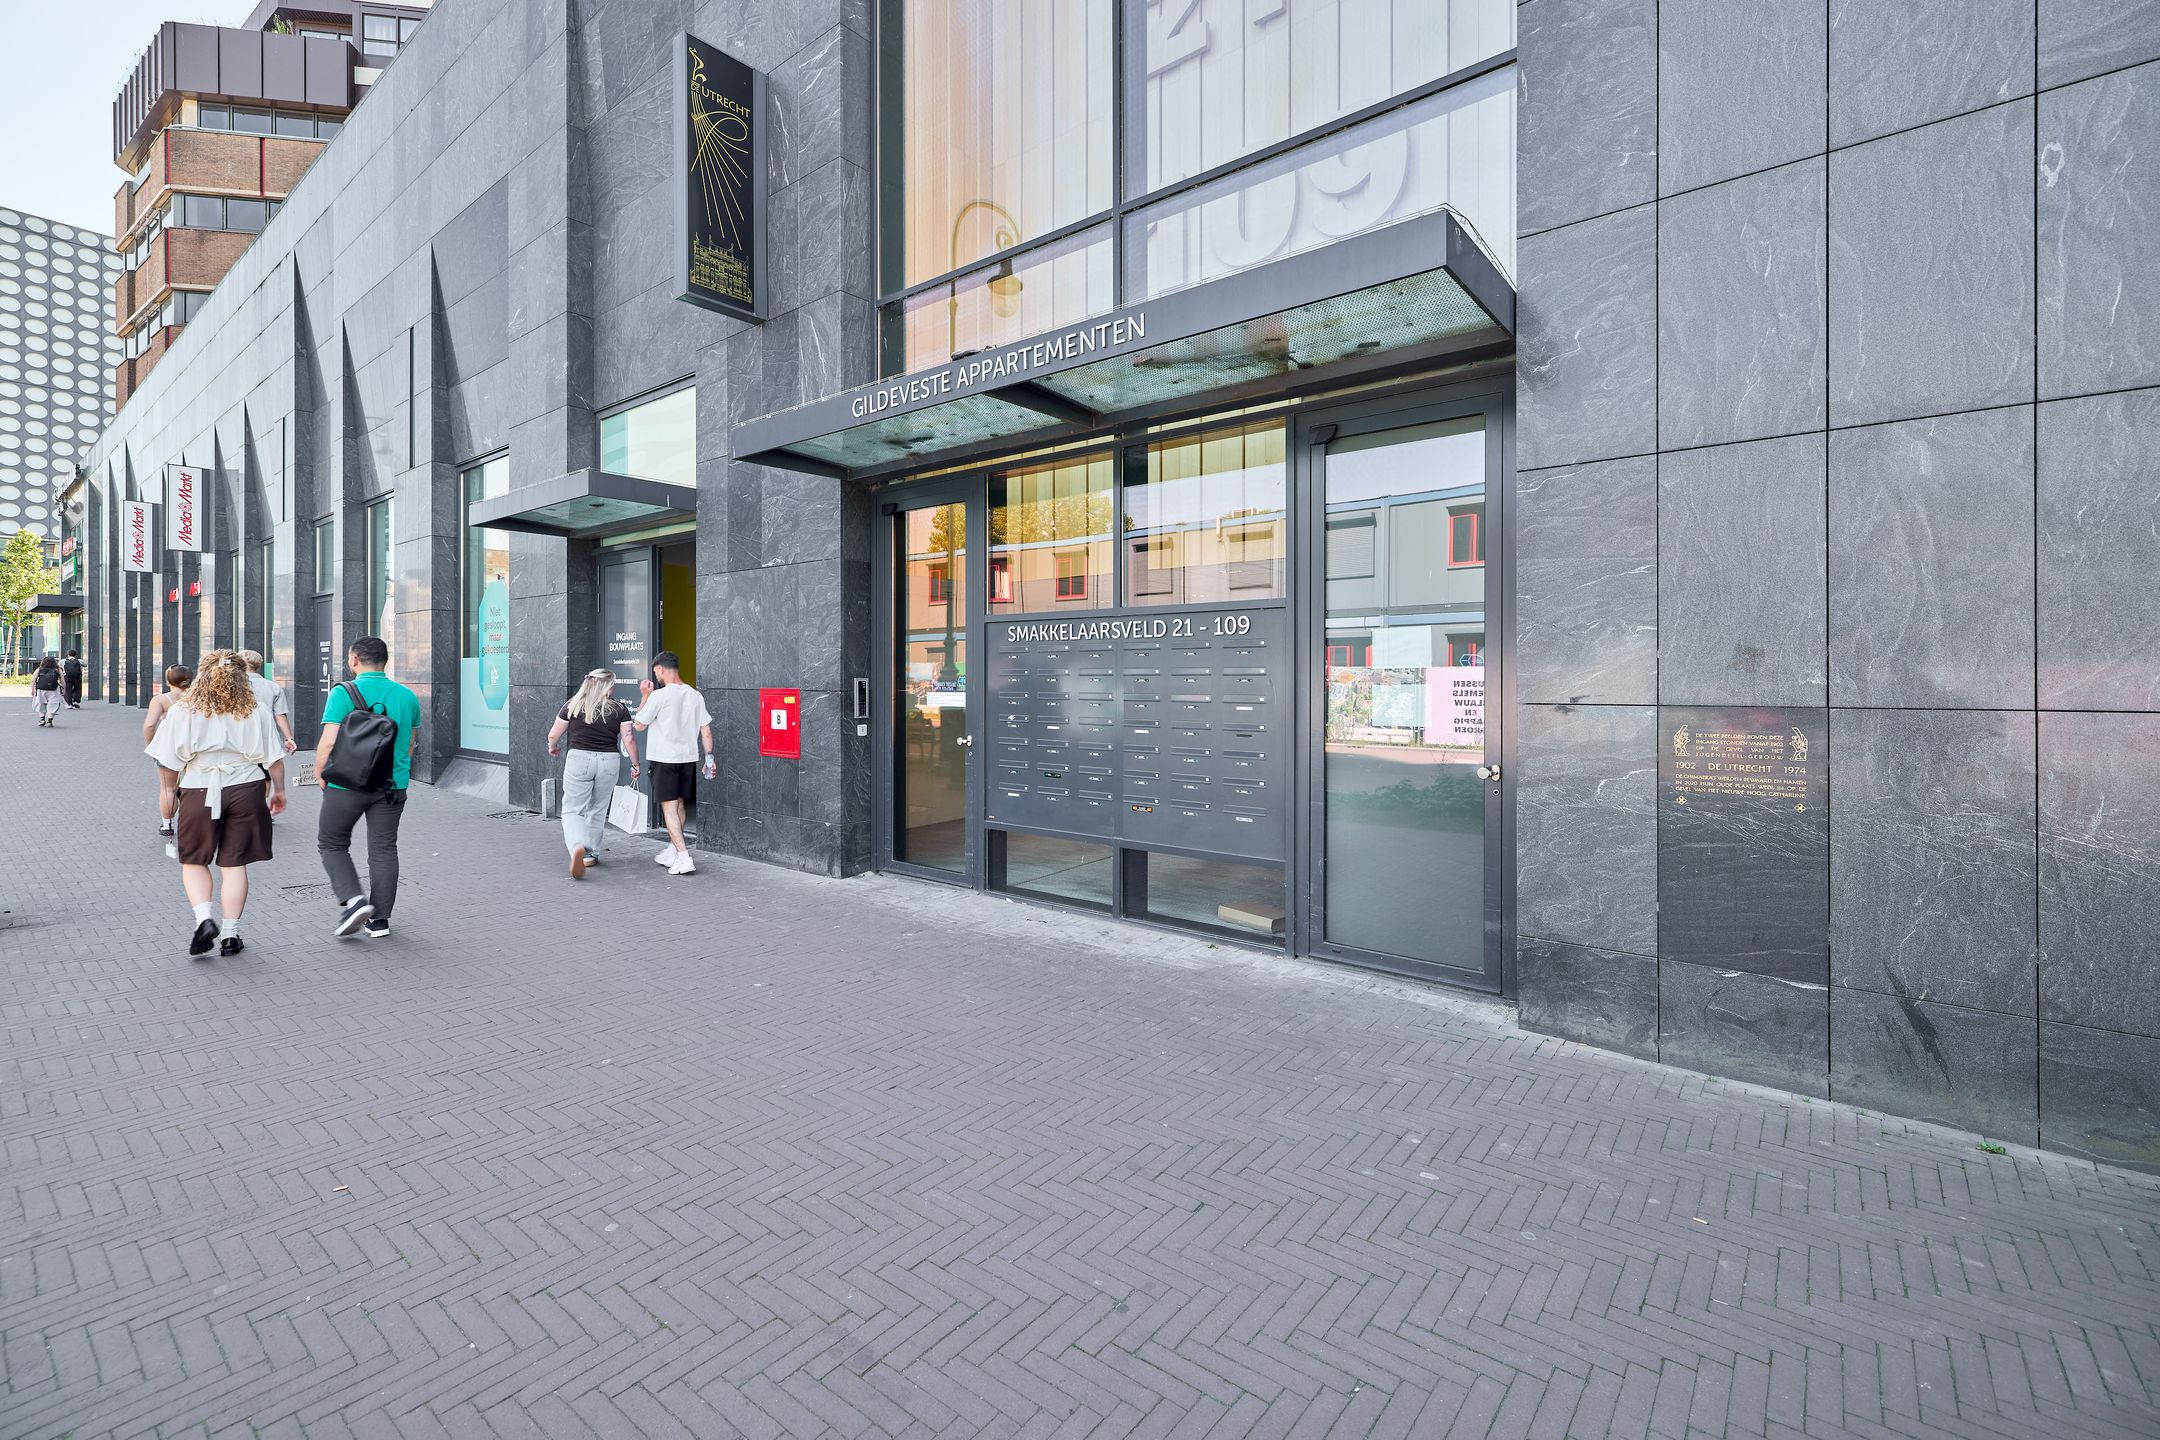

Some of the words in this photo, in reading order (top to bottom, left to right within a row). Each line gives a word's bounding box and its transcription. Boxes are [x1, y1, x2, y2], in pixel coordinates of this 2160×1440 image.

[702, 86, 750, 118] UTRECHT
[851, 370, 952, 418] GILDEVESTE
[956, 312, 1146, 390] APPARTEMENTEN
[178, 472, 193, 504] Markt
[132, 506, 145, 534] Markt
[178, 511, 193, 547] Media
[132, 539, 145, 568] Media
[616, 632, 637, 641] INGANG
[1007, 619, 1168, 642] SMAKKELAARSVELD
[1172, 618, 1194, 638] 21
[1214, 615, 1251, 636] 109
[609, 642, 644, 652] BOUWPLAATS
[776, 714, 782, 724] 8
[1675, 761, 1696, 770] 1902
[1708, 763, 1722, 771] DE
[1724, 764, 1773, 773] UTRECHT
[1784, 766, 1806, 774] 1974
[1696, 752, 1784, 760] JUGENDSTIL-GEBOUW
